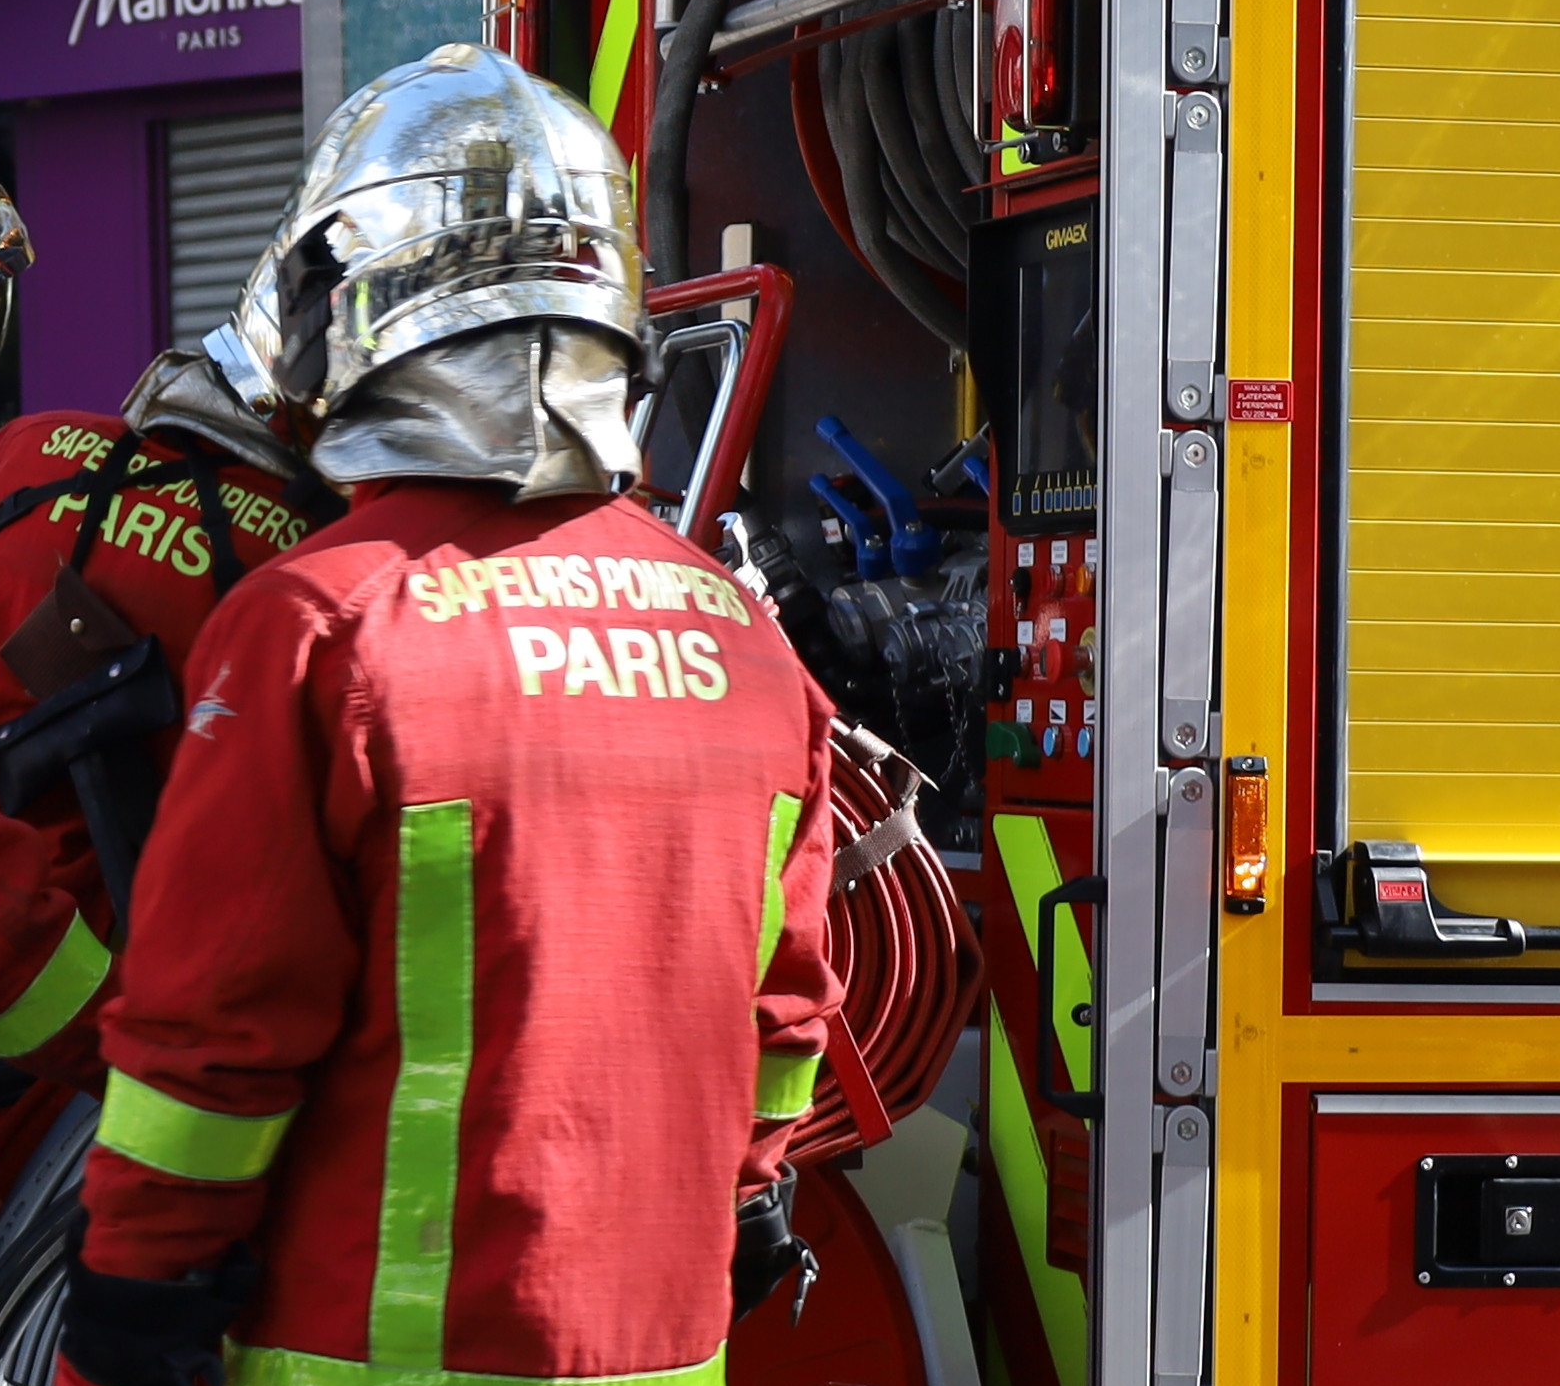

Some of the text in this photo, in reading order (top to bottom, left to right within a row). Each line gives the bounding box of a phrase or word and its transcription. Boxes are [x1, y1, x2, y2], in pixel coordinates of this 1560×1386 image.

[177, 27, 241, 51] PARIS
[1045, 222, 1088, 251] GIMAEX
[407, 554, 753, 627] SAPEURS POMPIERS
[506, 625, 730, 701] PARIS
